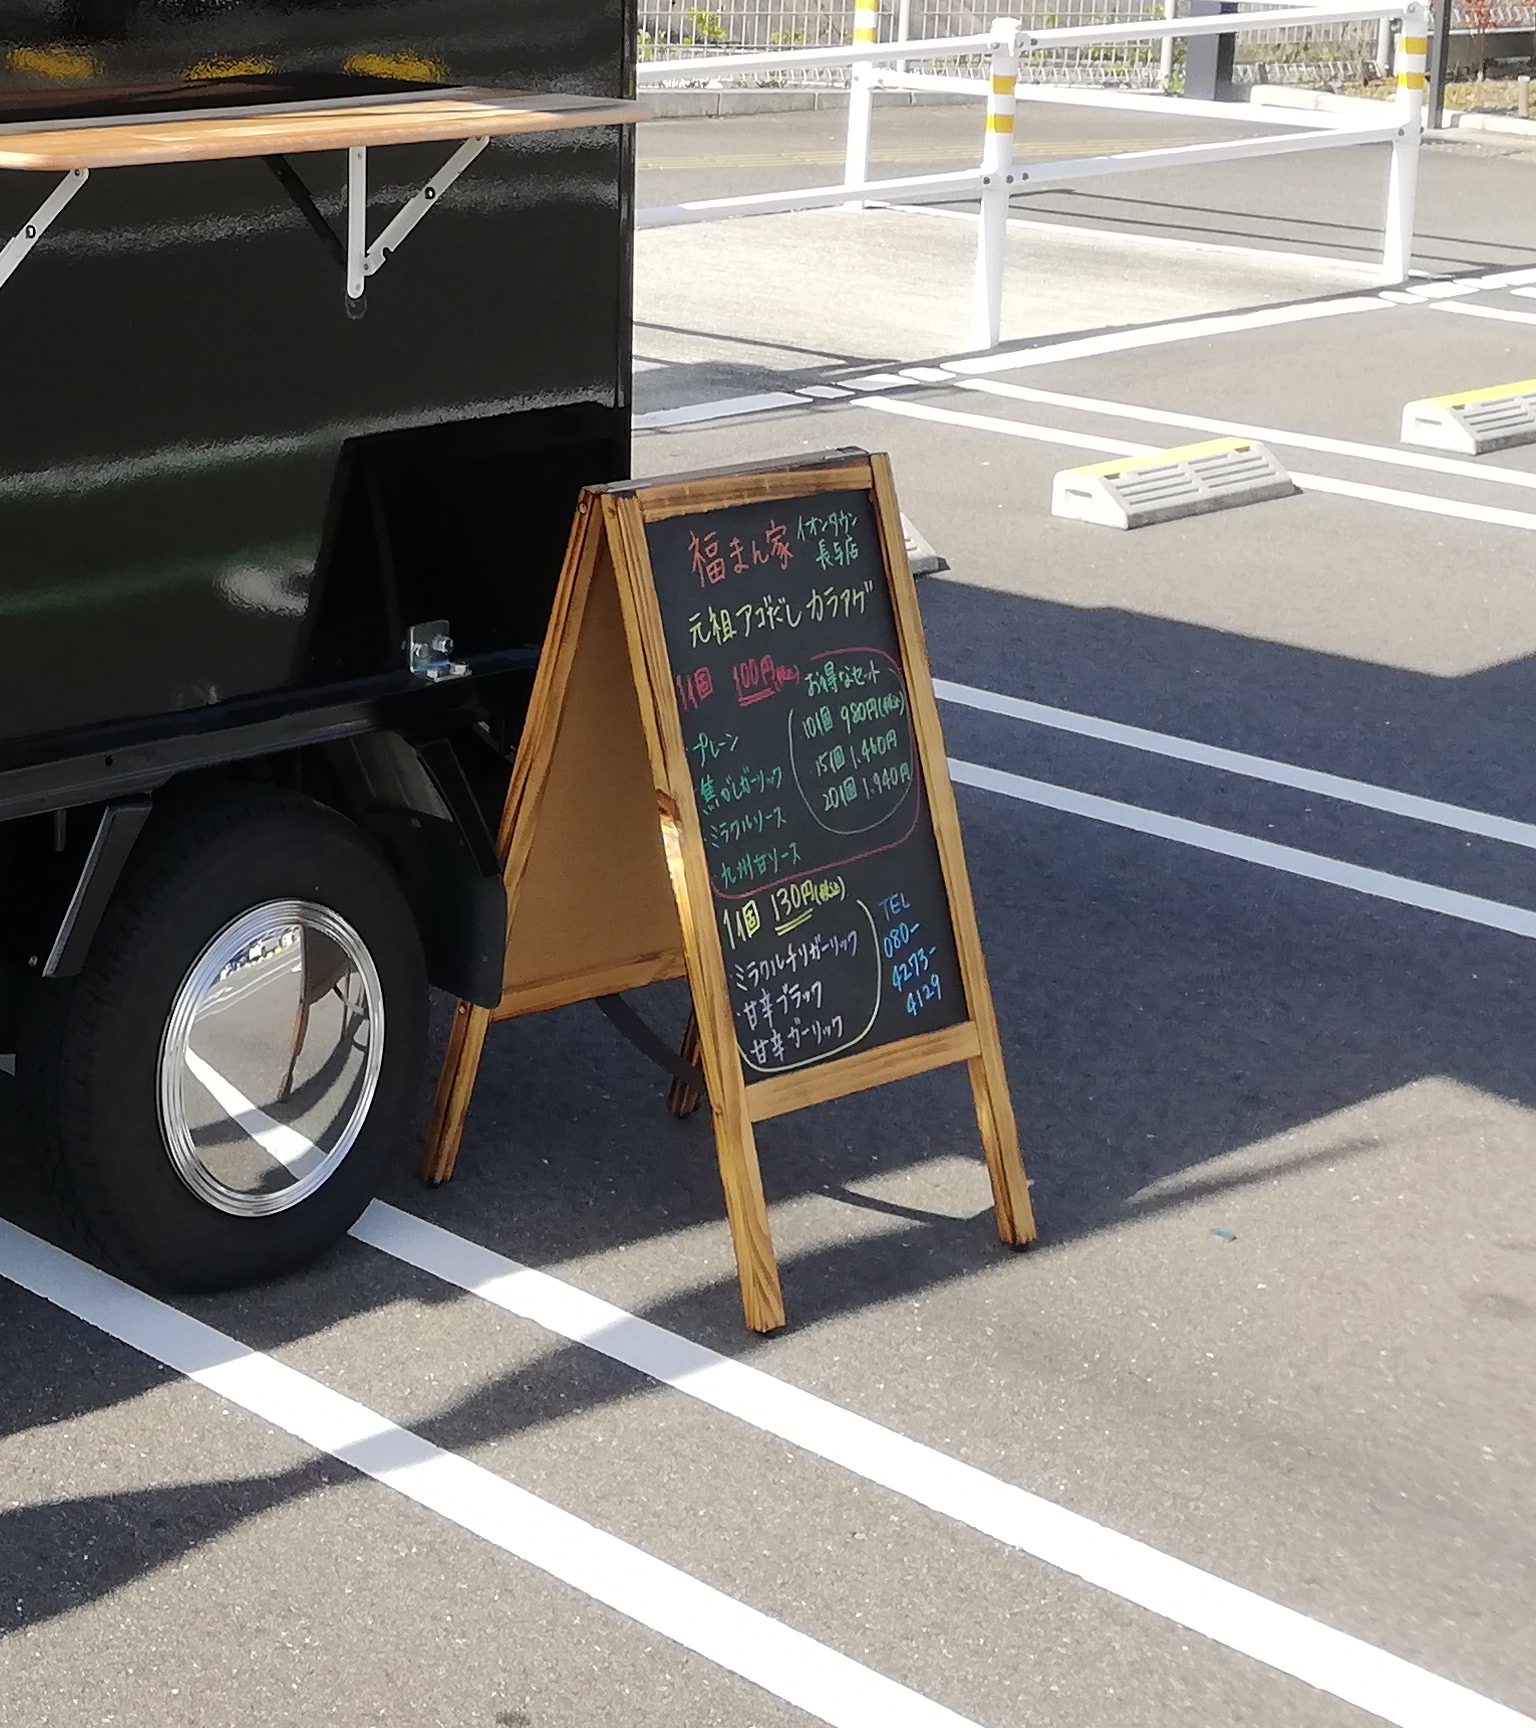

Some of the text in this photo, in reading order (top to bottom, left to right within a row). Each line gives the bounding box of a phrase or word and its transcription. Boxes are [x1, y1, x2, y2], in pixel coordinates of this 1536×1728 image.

[797, 510, 858, 542] イオンタウン
[688, 519, 793, 588] 福まん家
[816, 536, 859, 571] 長与店
[804, 660, 881, 698] お得なセット
[691, 731, 739, 768] プレーン
[815, 745, 846, 778] 15個
[699, 765, 782, 816] 焦がしガーリック
[822, 775, 858, 812] 20個
[709, 805, 787, 849] ミラクルソース
[720, 841, 802, 890] 九州甘ソース
[879, 892, 912, 921] TEL
[735, 929, 859, 992] ミラクルチリガーリック
[742, 980, 823, 1031] 甘辛ブラック
[905, 973, 942, 1017] 4129
[749, 1015, 844, 1064] 甘辛ガーリック
